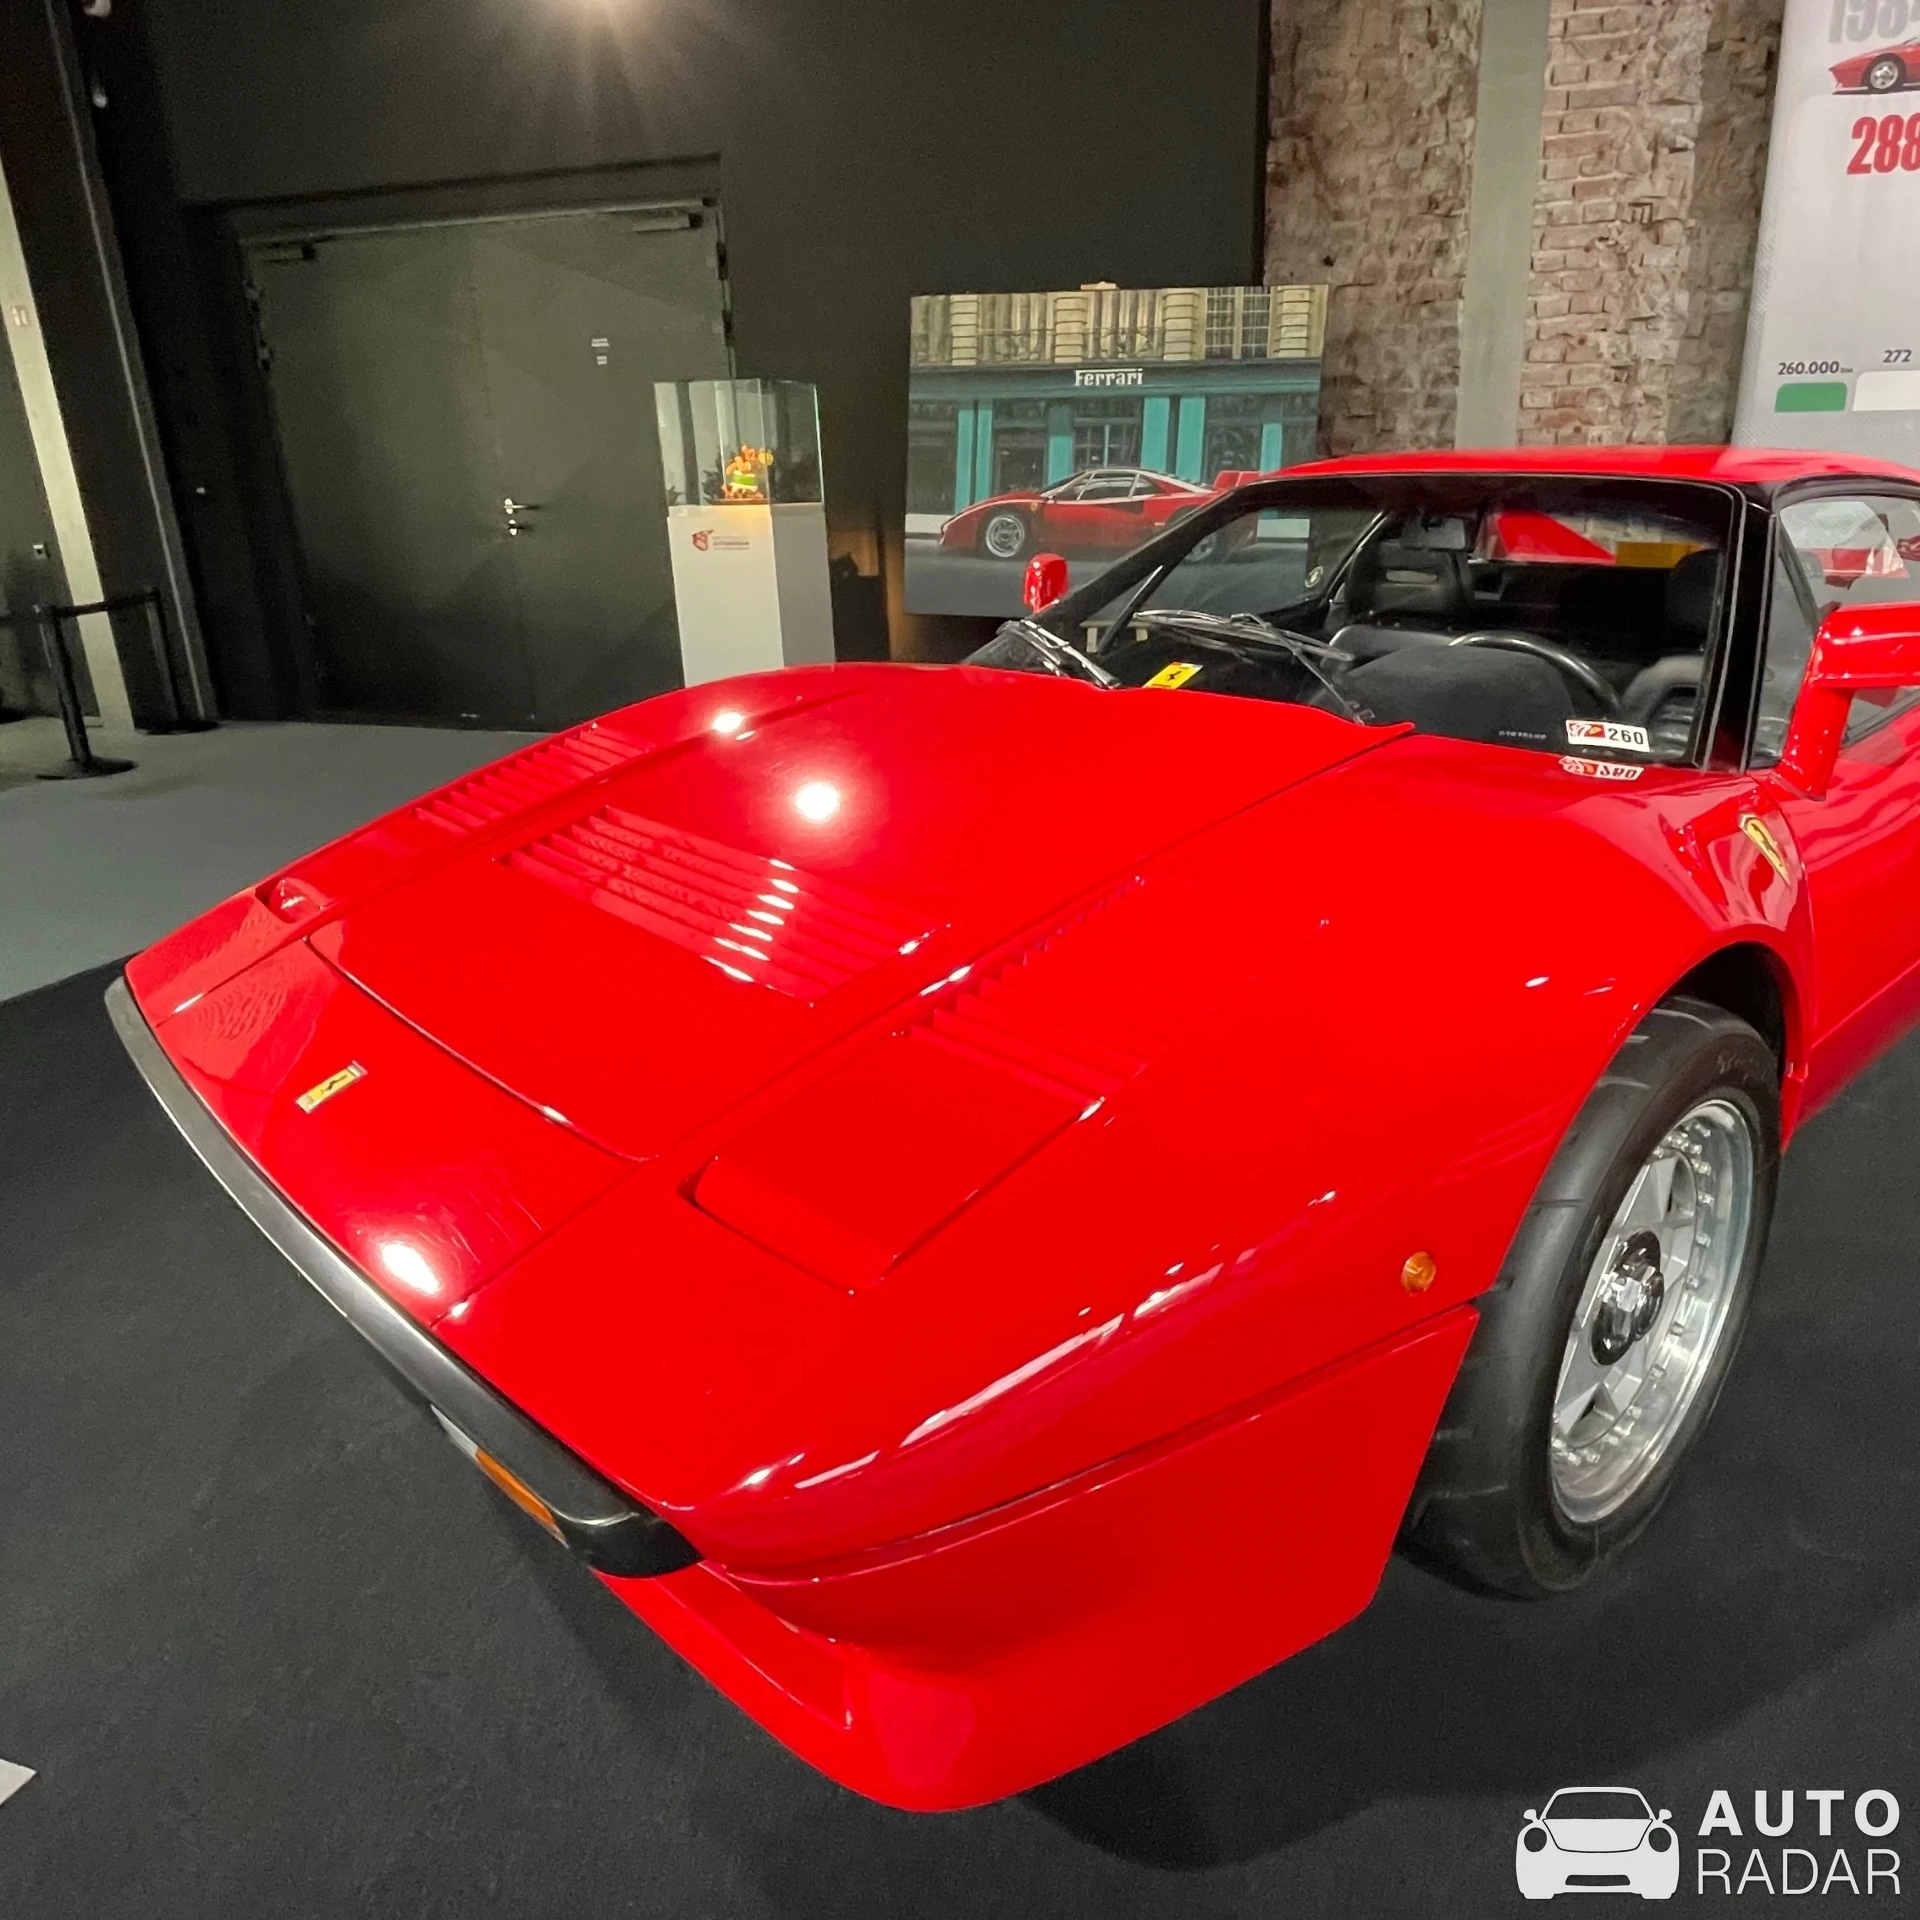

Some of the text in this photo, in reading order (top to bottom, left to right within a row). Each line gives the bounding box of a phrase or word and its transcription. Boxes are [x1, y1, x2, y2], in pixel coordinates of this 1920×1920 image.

[1828, 0, 1920, 43] 198
[1847, 112, 1920, 175] 288
[1883, 349, 1912, 363] 272
[1778, 361, 1840, 375] 260.000
[1074, 368, 1143, 387] Ferrari
[1608, 728, 1644, 745] 260
